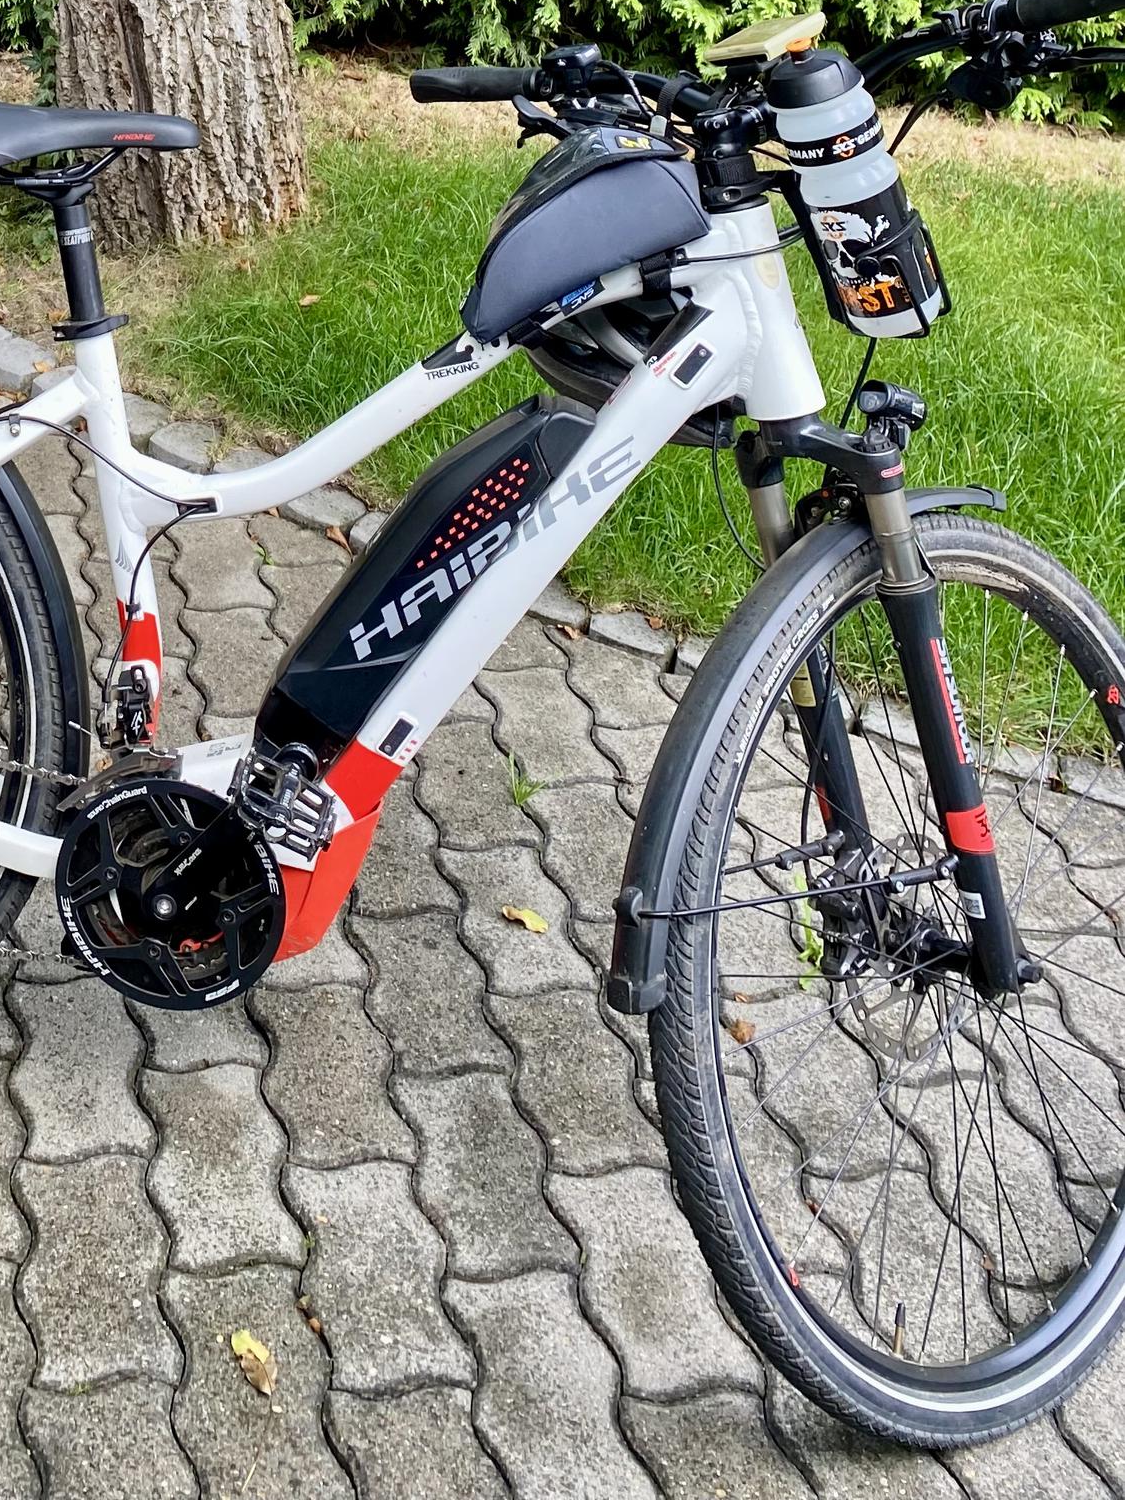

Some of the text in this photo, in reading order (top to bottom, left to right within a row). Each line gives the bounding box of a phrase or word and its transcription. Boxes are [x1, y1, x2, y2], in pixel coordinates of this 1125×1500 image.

[425, 361, 480, 380] TREKKING
[349, 435, 641, 661] HAIBIKE
[763, 643, 794, 697] PROTEK
[791, 609, 820, 647] CROSS
[102, 786, 147, 810] ChainGuard
